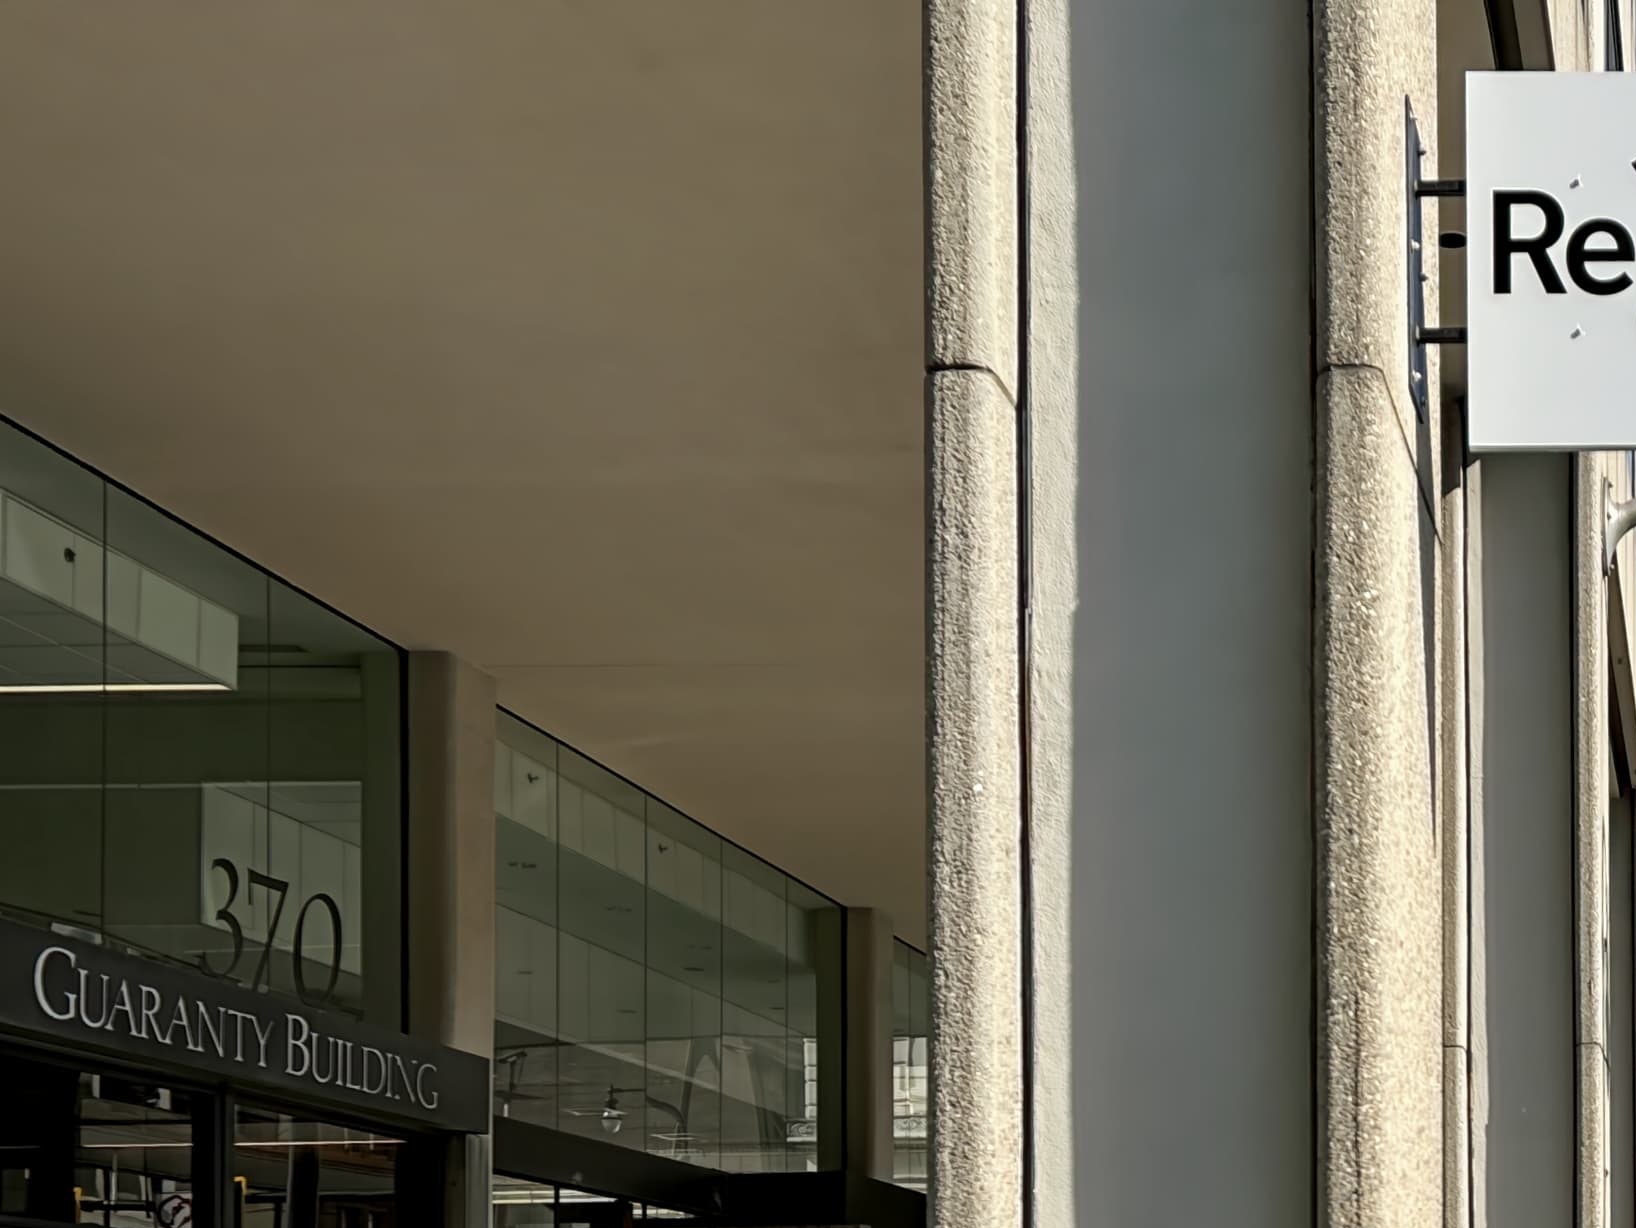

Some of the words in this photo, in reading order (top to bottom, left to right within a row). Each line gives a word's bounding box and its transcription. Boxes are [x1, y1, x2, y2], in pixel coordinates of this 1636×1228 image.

[200, 857, 343, 1000] 370
[33, 946, 276, 1068] GUARANTY
[285, 1012, 439, 1110] BUILDING
